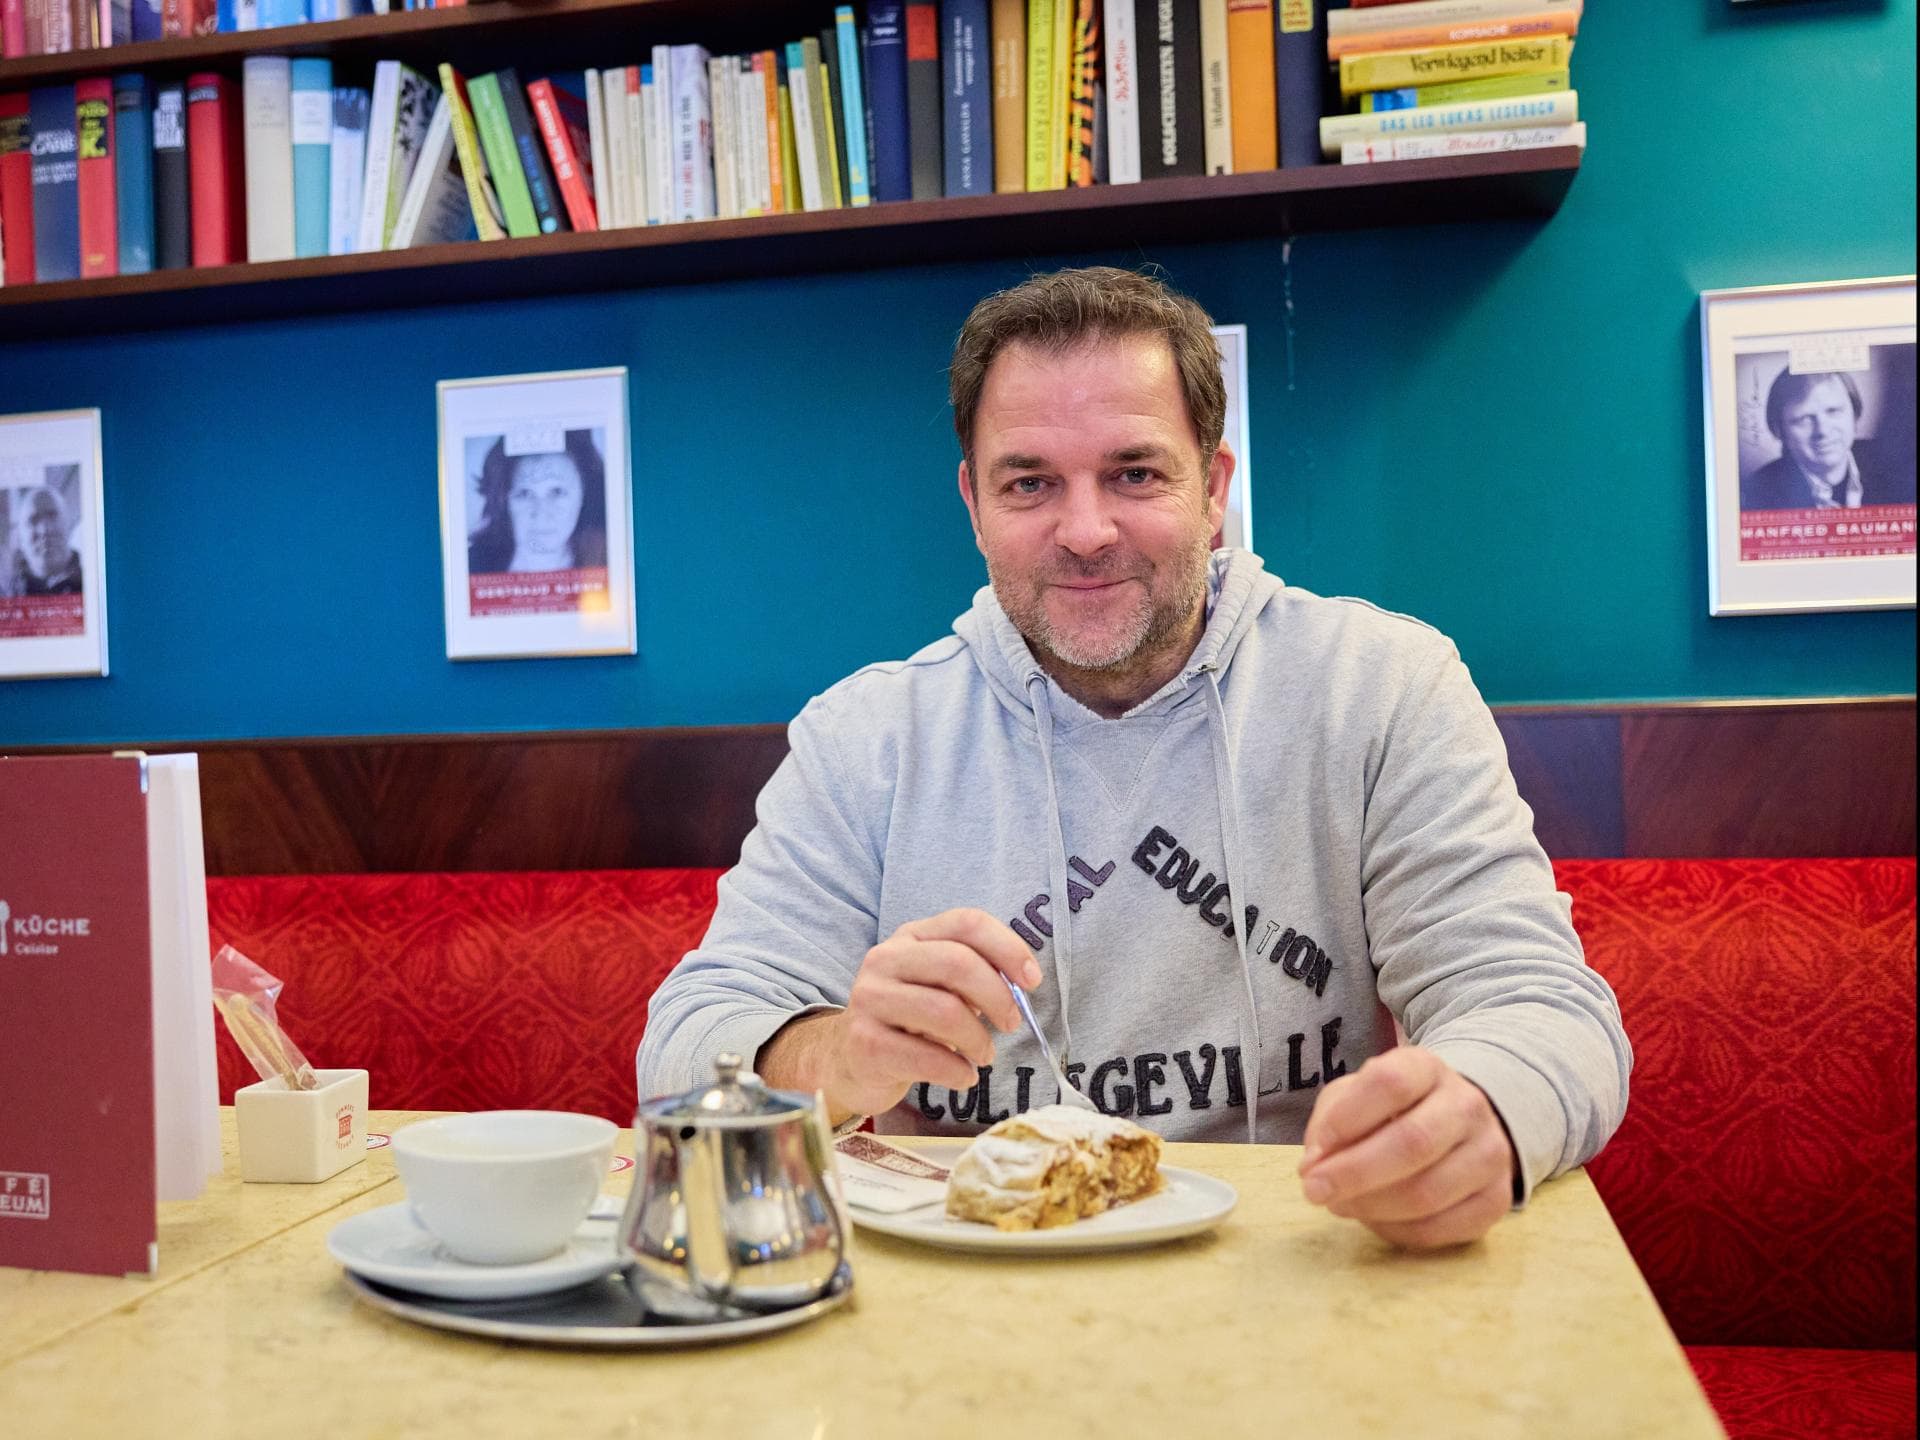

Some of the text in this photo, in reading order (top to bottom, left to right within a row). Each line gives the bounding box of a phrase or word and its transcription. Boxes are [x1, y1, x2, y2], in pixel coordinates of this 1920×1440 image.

[1410, 46, 1544, 73] Vorwiegend heiter
[1379, 100, 1556, 132] DAS LEO LUKAS LESEBUCH
[1740, 520, 1916, 539] MANFRED BAUMAN
[1131, 825, 1333, 998] EDUCATION
[13, 914, 91, 937] KÜCHE
